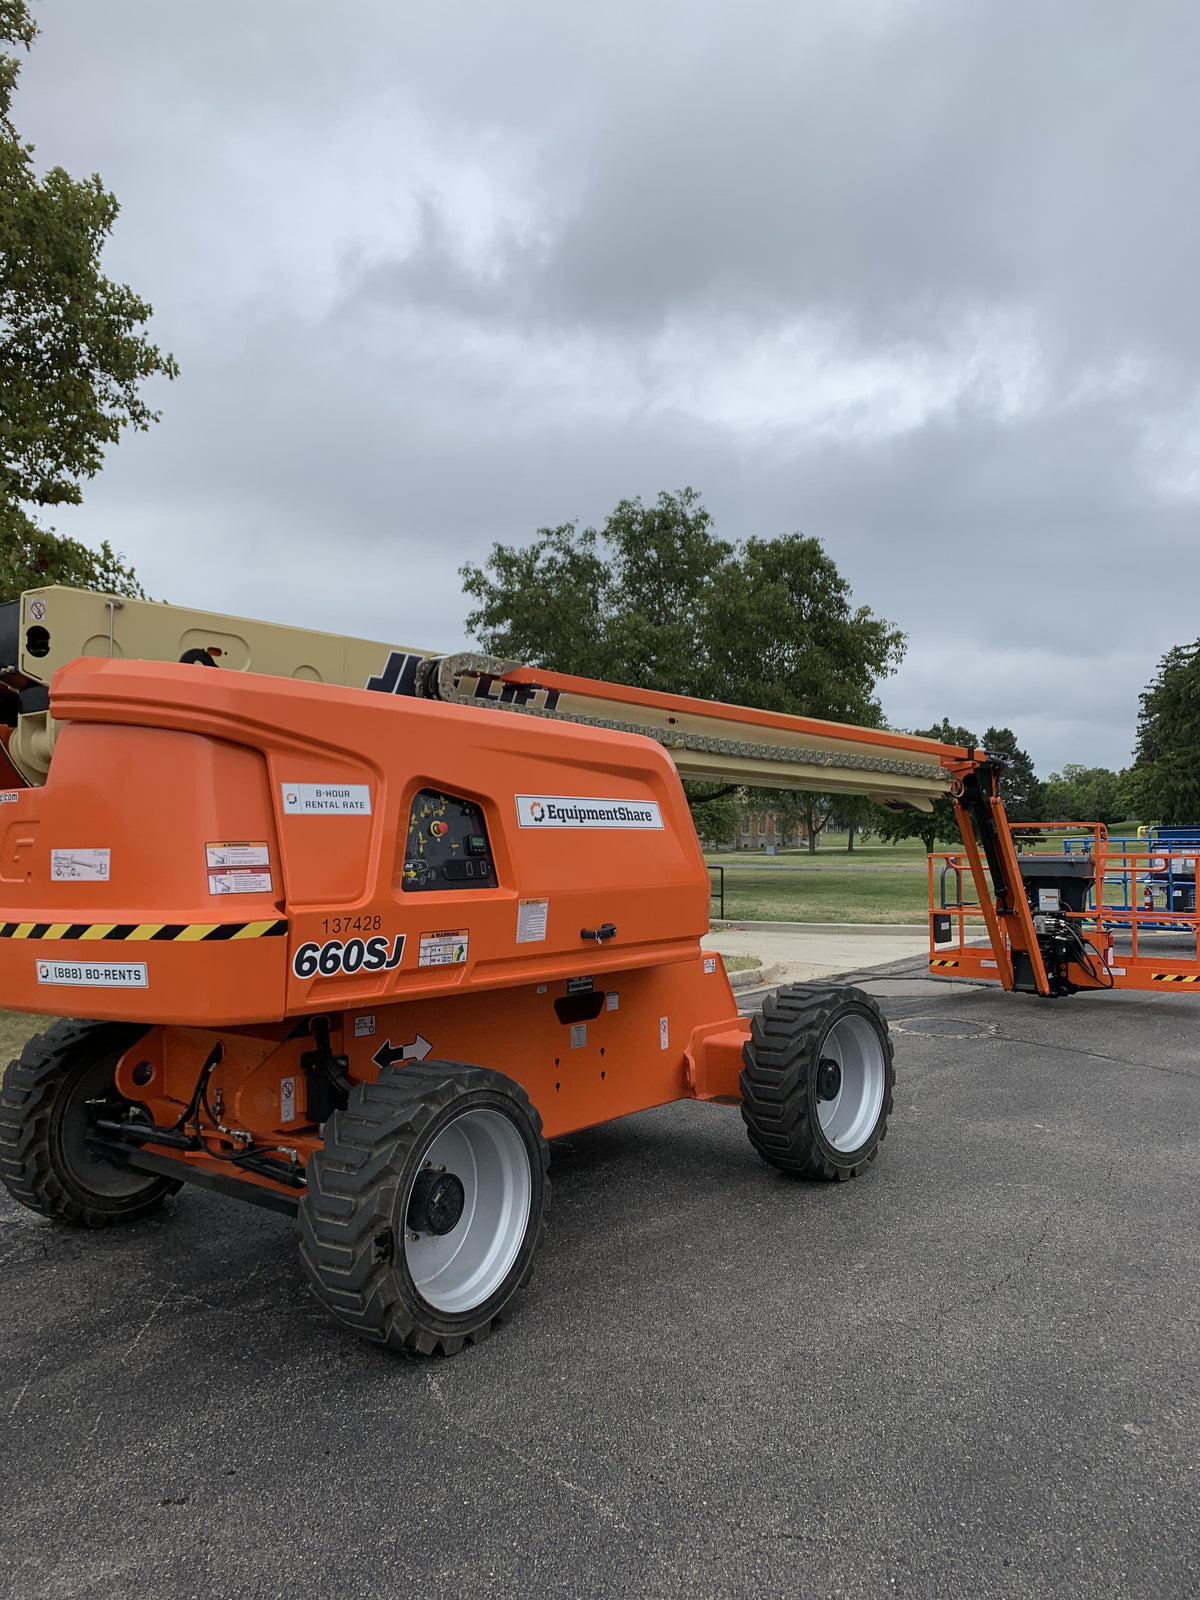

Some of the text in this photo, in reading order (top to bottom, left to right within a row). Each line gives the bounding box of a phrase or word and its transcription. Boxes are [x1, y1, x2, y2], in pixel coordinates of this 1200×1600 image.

[315, 789, 351, 798] 8-HOUR
[305, 800, 365, 809] RENTAL RATE
[546, 804, 653, 823] EquipmentShare
[322, 915, 382, 934] 137428
[294, 934, 406, 978] 660SJ
[54, 966, 141, 981] (888) 80-RENTS
